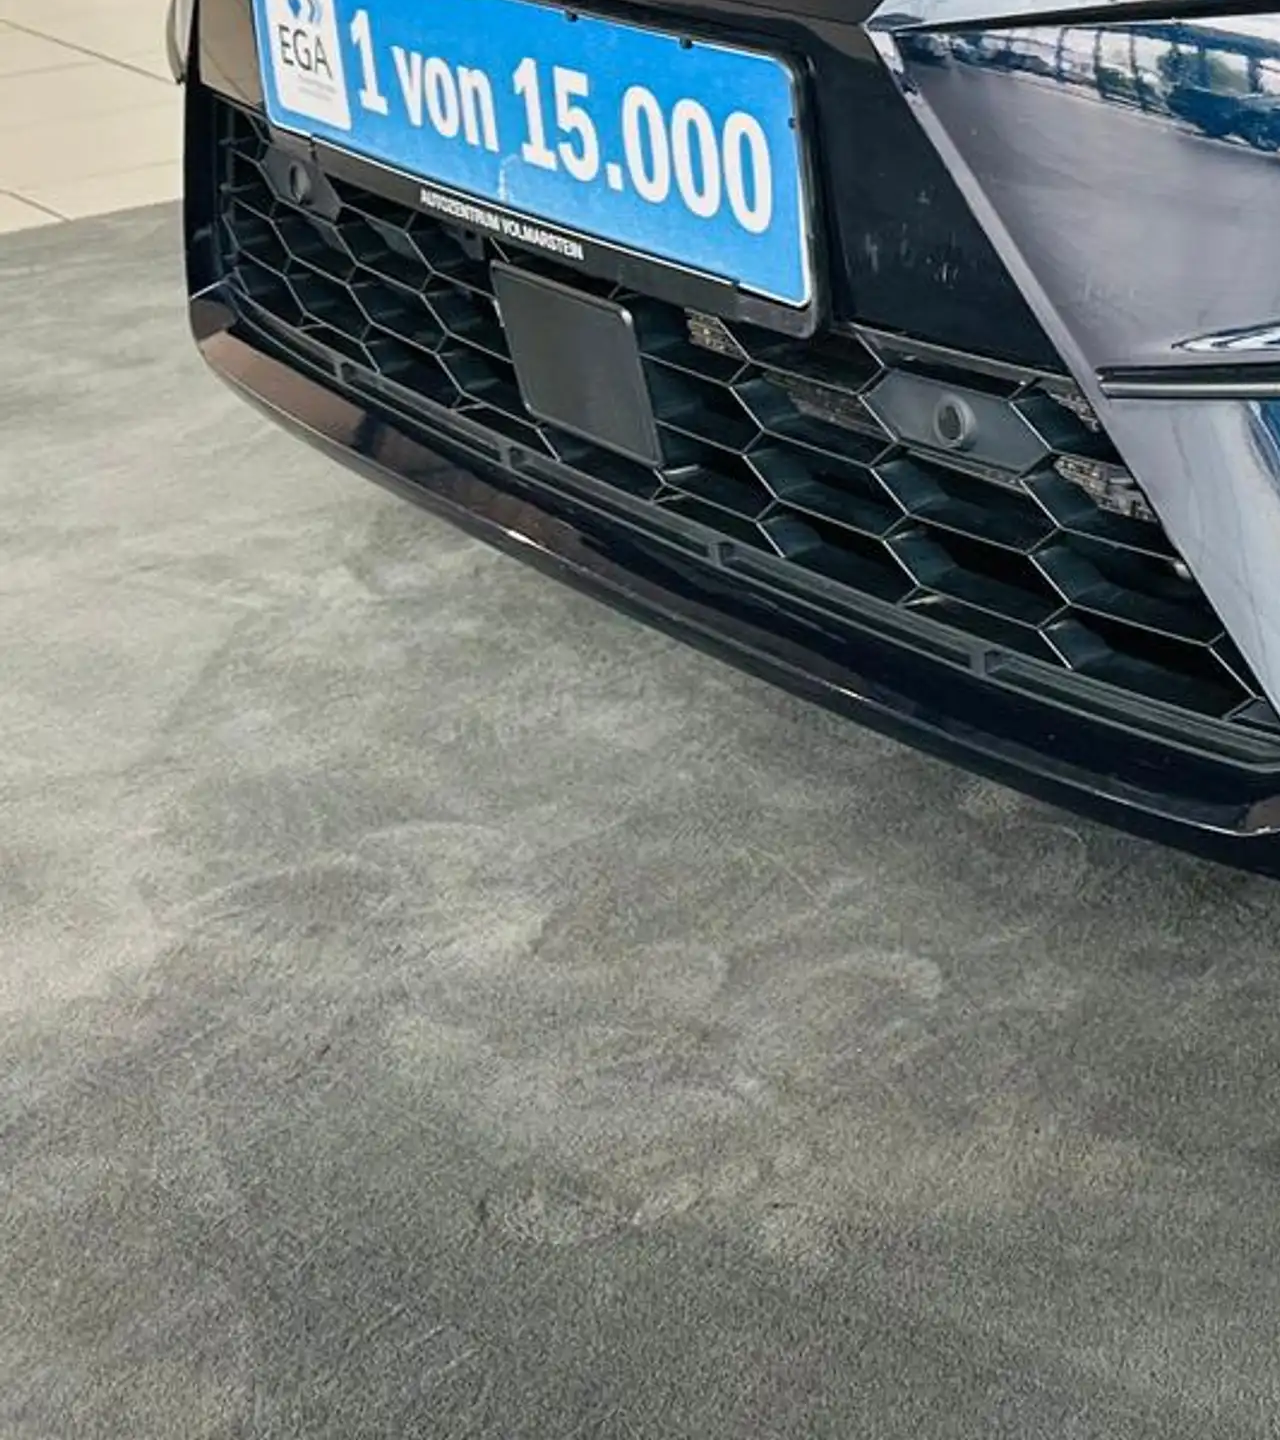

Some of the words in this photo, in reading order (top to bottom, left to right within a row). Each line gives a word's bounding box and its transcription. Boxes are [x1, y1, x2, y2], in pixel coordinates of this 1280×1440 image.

[277, 23, 334, 80] EGA
[350, 9, 389, 116] 1
[390, 45, 500, 152] von
[512, 57, 773, 233] 15.000
[420, 187, 500, 231] AUTOZENTRUM
[502, 218, 584, 260] VOLMARSTEIN
